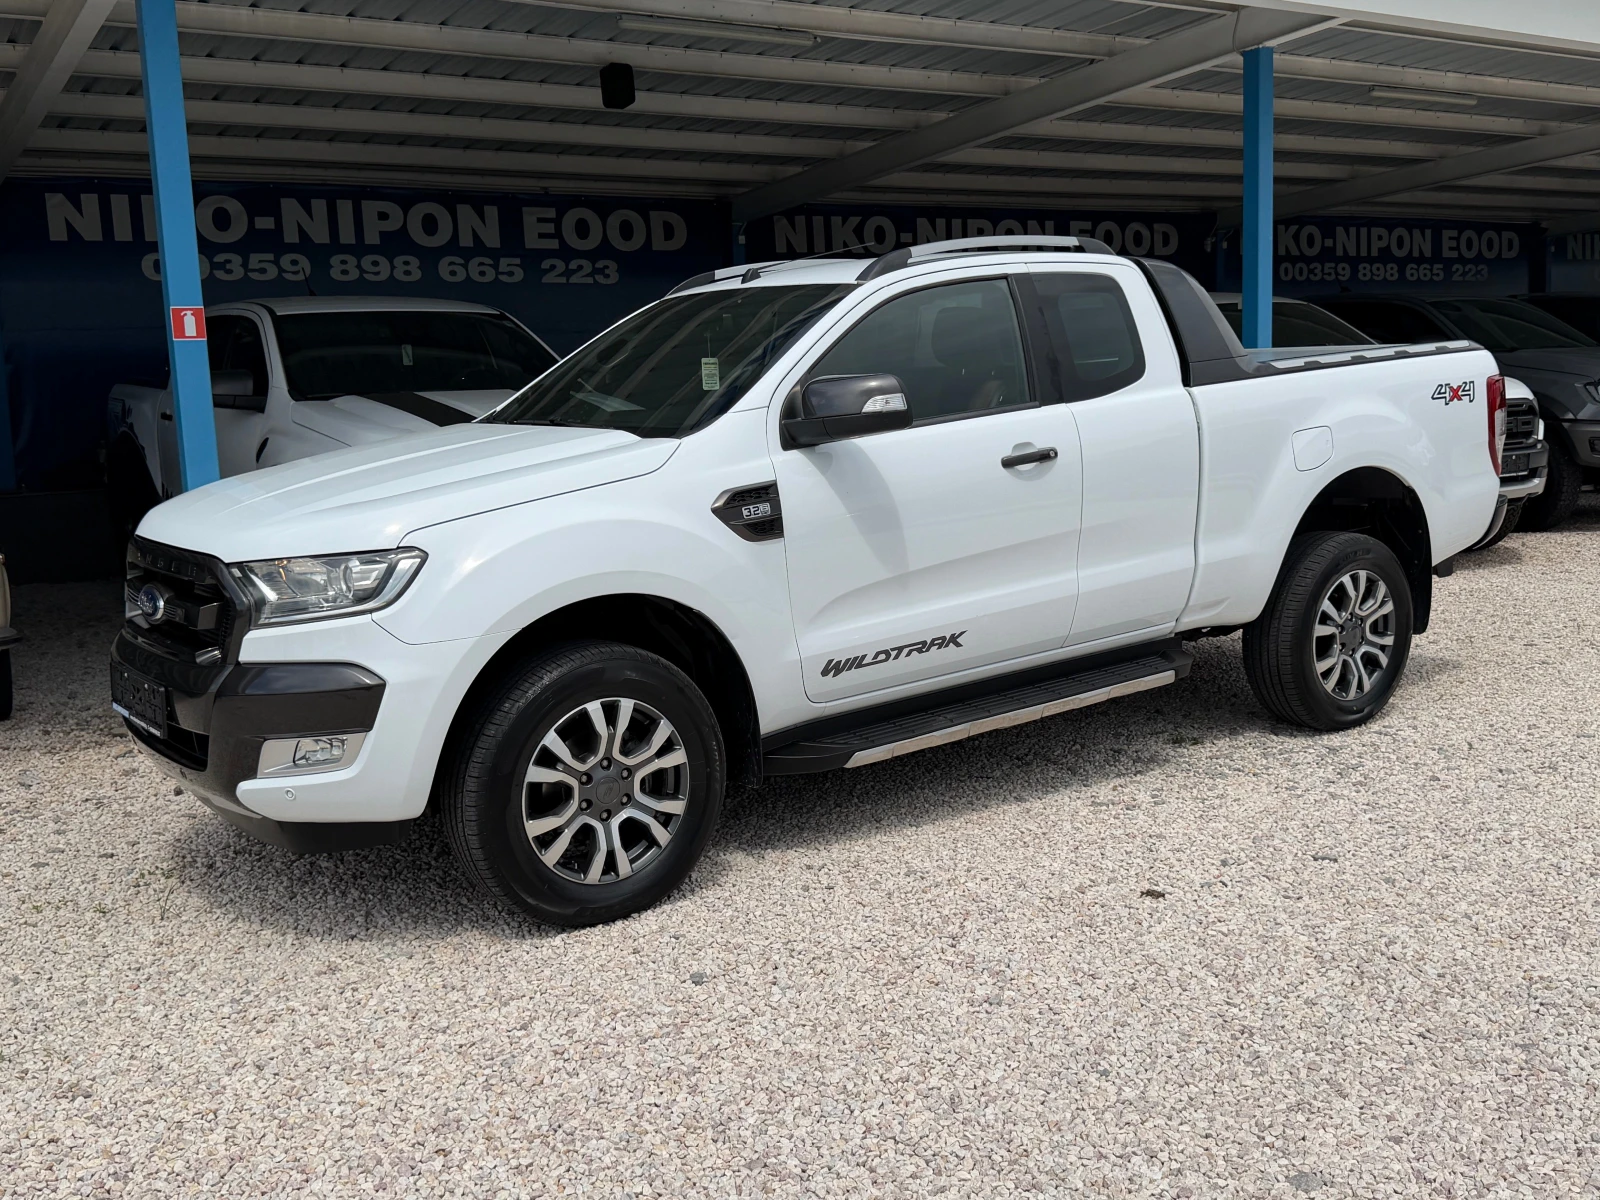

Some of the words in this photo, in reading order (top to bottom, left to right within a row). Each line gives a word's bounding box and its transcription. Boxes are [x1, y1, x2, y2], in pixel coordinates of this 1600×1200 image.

[522, 207, 688, 251] EOOD
[1240, 225, 1432, 258] KO-NIPON
[1442, 229, 1520, 259] EOOD
[329, 254, 422, 282] 898
[438, 256, 524, 283] 665
[541, 258, 620, 285] 223
[1280, 262, 1351, 281] 00359
[1358, 262, 1399, 281] 898
[1405, 263, 1444, 281] 665
[1451, 263, 1489, 281] 223
[820, 630, 969, 678] WILDTRAK
